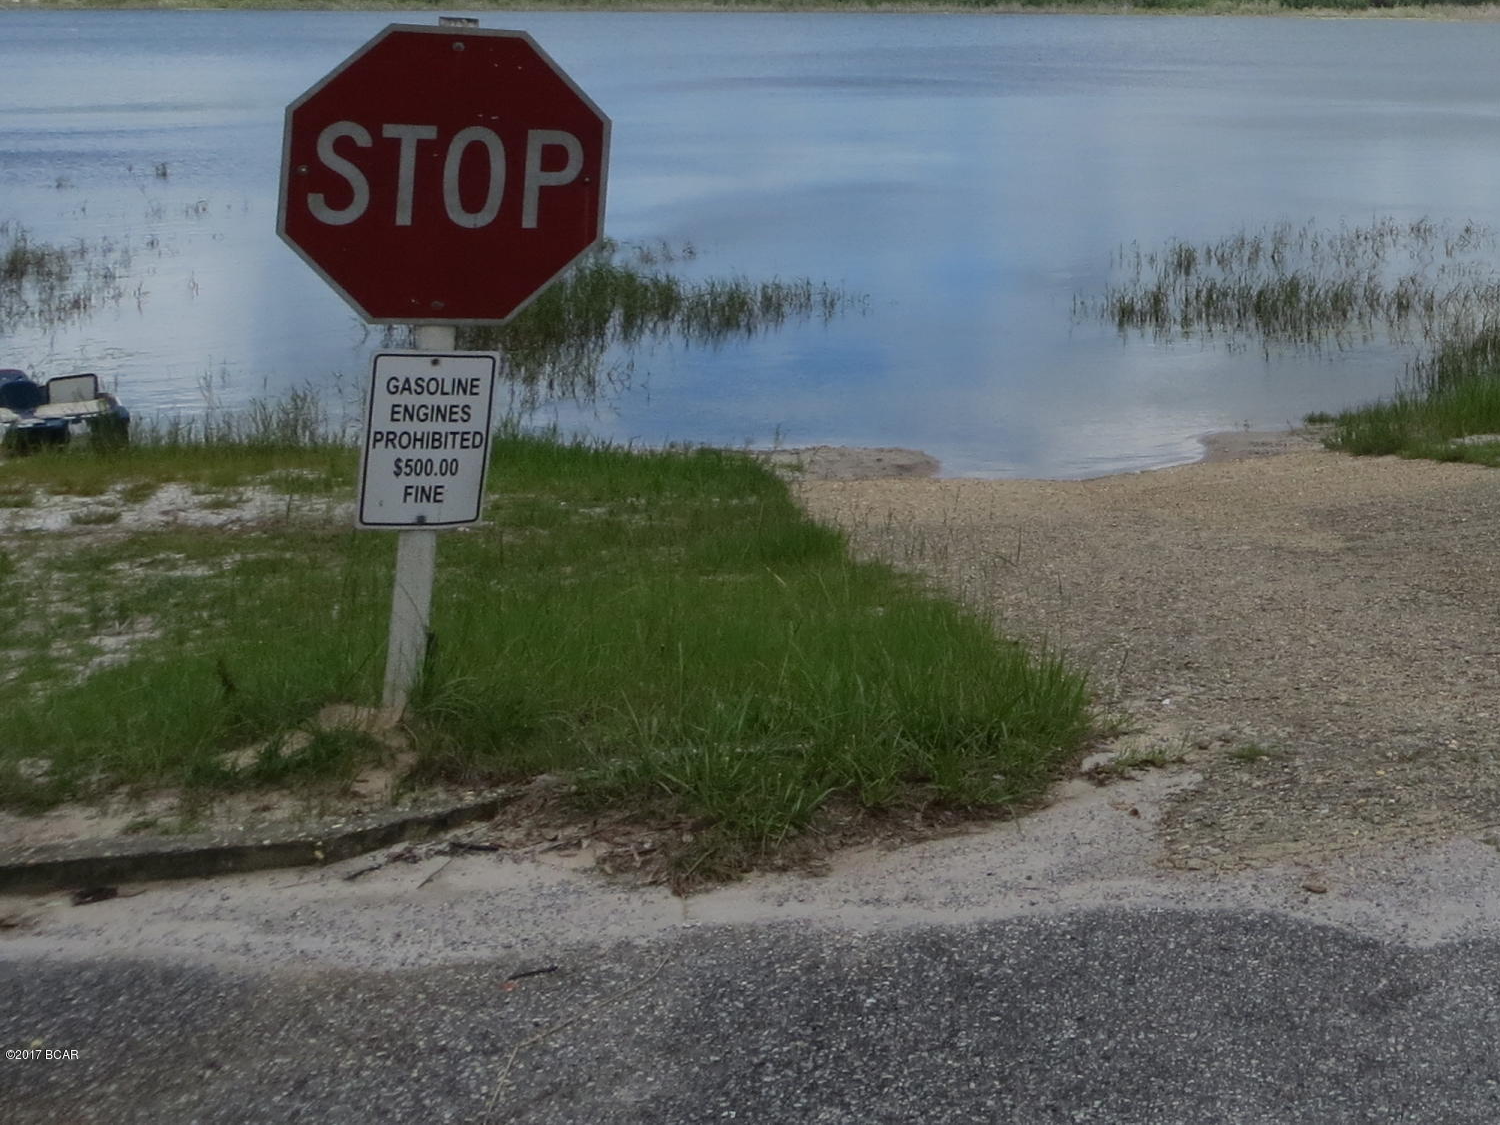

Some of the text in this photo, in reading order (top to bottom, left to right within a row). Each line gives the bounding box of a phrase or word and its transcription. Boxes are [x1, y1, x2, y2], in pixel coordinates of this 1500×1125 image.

[307, 120, 584, 229] STOP
[386, 376, 480, 396] GASOLINE
[390, 404, 471, 422] ENGINES
[372, 431, 484, 449] PROHIBITED
[393, 458, 459, 477] $500.00
[403, 485, 445, 503] FINE
